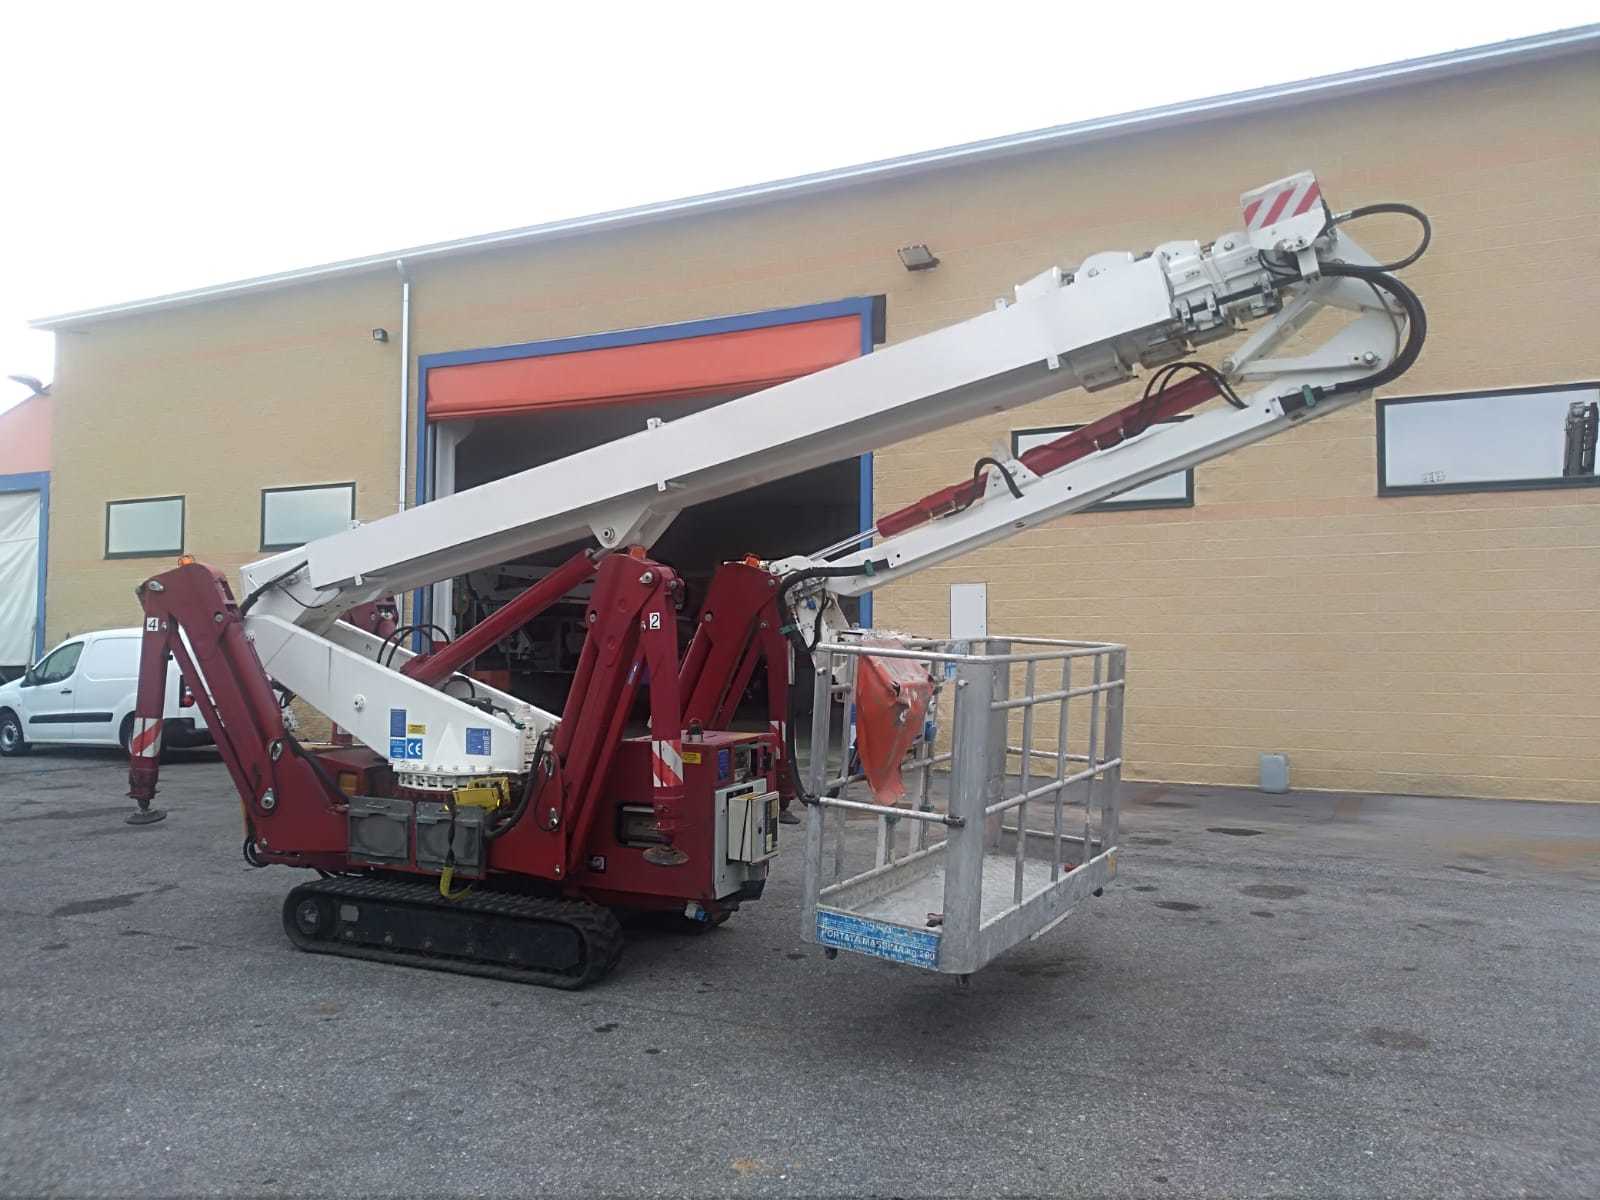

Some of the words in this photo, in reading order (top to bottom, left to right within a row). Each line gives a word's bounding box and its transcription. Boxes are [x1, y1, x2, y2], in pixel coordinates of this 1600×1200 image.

[148, 619, 156, 630] 4
[651, 614, 659, 628] 2
[408, 742, 422, 756] CE
